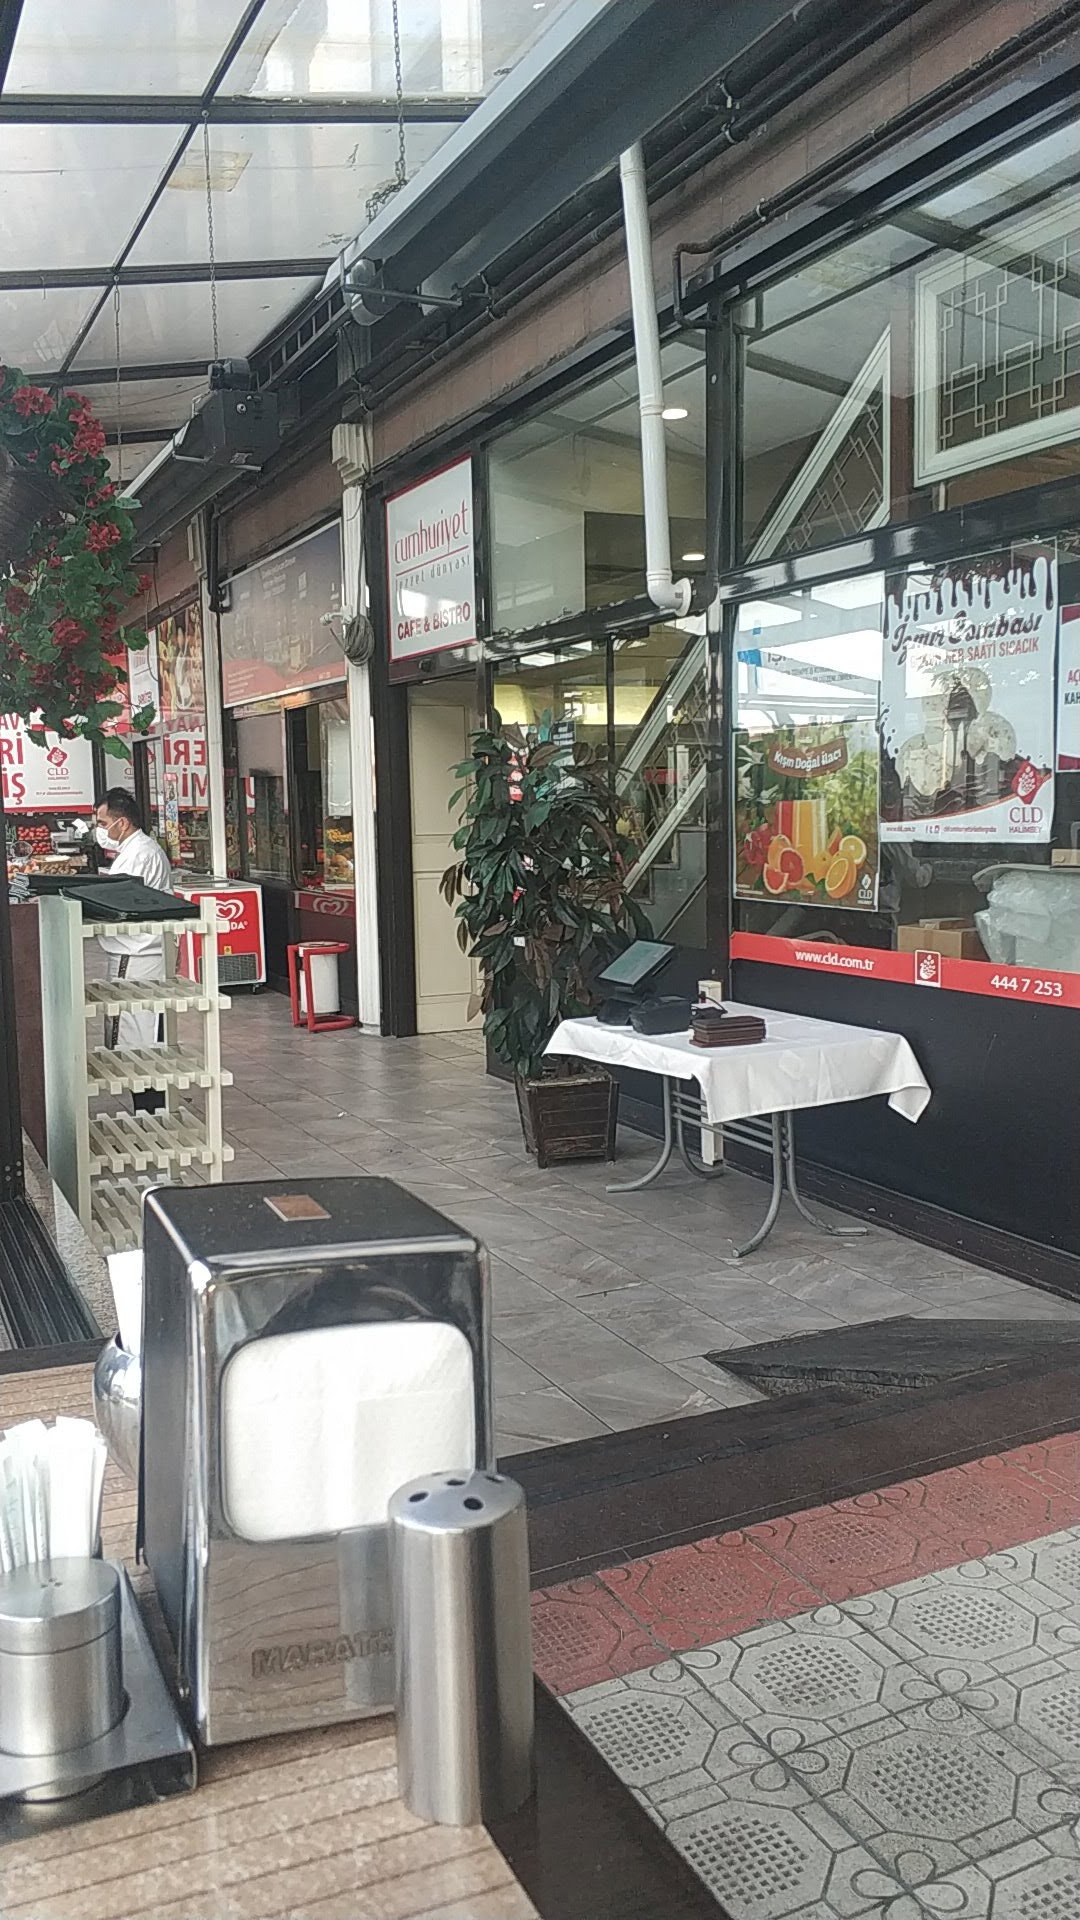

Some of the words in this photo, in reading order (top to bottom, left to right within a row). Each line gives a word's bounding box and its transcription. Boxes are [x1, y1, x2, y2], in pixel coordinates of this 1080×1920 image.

[394, 499, 469, 564] cumhuriyet
[397, 617, 422, 641] CAFE
[423, 615, 431, 634] &
[47, 767, 69, 776] CLD
[1009, 806, 1043, 824] CLD
[795, 949, 874, 971] www.cld.com.tr
[990, 974, 1018, 991] 444
[1021, 977, 1030, 993] 7
[1033, 979, 1063, 998] 253
